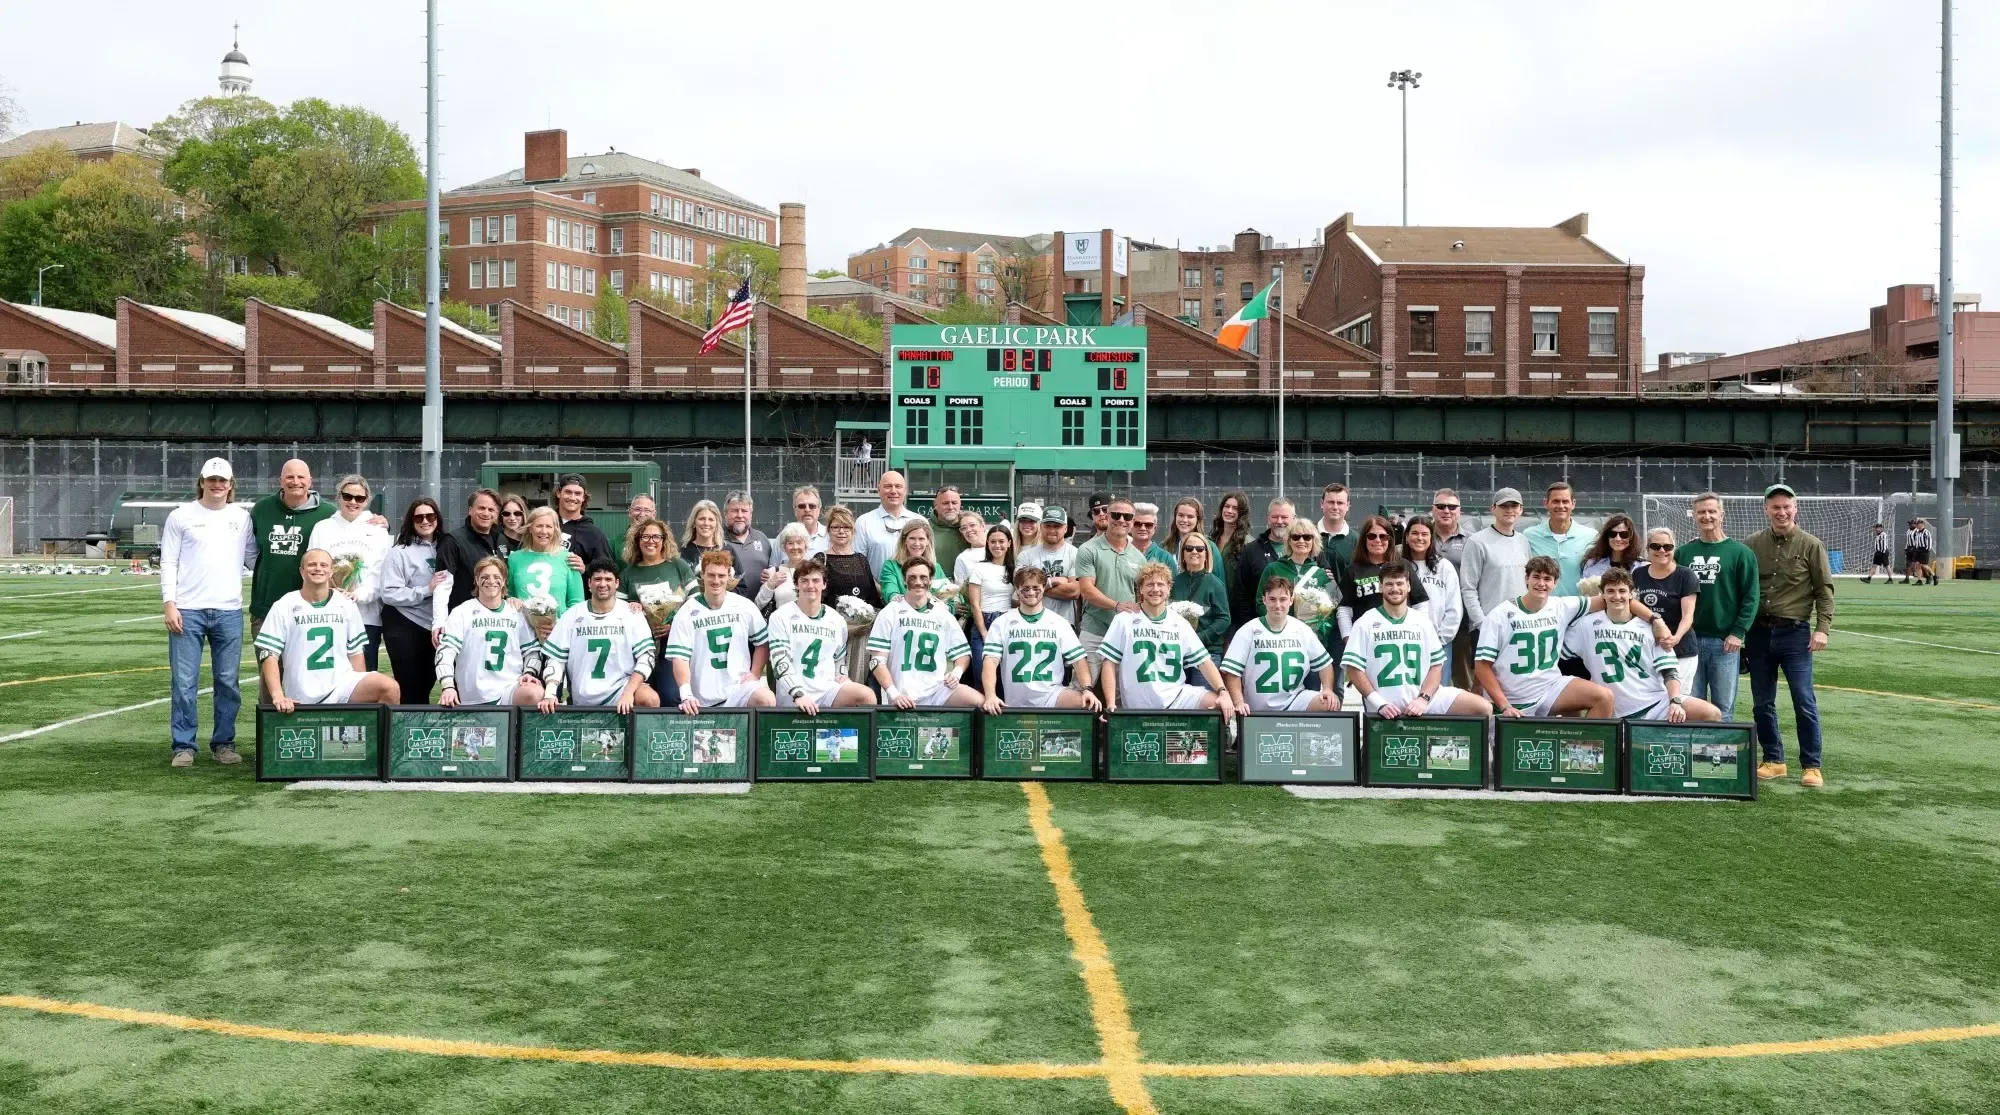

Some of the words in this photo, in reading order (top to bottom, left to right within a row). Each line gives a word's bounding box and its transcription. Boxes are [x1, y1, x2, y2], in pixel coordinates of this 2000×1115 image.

[940, 326, 1029, 345] GAELIC
[1034, 326, 1097, 345] PARK
[898, 351, 953, 361] MANHATTAN
[1090, 351, 1134, 362] CANISIUS
[928, 367, 940, 388] 0
[993, 376, 1029, 387] PERIOD
[1114, 368, 1126, 389] 0
[903, 397, 931, 405] GOALS
[949, 397, 979, 405] POINTS
[1059, 398, 1087, 406] GOALS
[1105, 398, 1134, 406] POINTS
[968, 506, 1000, 516] PARK
[271, 534, 300, 542] JASPERS
[526, 561, 553, 598] 3
[1420, 576, 1447, 589] ATTAN
[1510, 616, 1558, 631] MANHATTAN
[576, 625, 625, 637] MANHATTAN
[1008, 629, 1057, 640] MANHATTAN
[1132, 628, 1180, 641] MANHATTAN
[1373, 631, 1421, 642] MANHATTAN
[1594, 628, 1645, 643] MANHATTAN
[307, 626, 335, 671] 2
[706, 626, 733, 670] 5
[1253, 639, 1302, 649] MANHATTAN
[485, 630, 509, 672] 3
[901, 629, 940, 672] 18
[1509, 628, 1559, 675] 30
[587, 638, 612, 679] 7
[800, 638, 823, 679] 4
[1008, 641, 1058, 683] 22
[1132, 640, 1182, 683] 23
[1594, 641, 1650, 684] 34
[1373, 643, 1422, 688] 29
[1254, 651, 1305, 694] 26
[282, 739, 313, 748] JASPERS
[410, 739, 442, 748] JASPERS
[541, 740, 572, 749] JASPERS
[654, 741, 684, 750] JASPERS
[777, 741, 807, 750] JASPERS
[880, 739, 909, 748] JASPERS
[1002, 740, 1031, 749] JASPERS
[1127, 742, 1157, 751] JASPERS
[1262, 744, 1292, 753] JASPERS
[1388, 747, 1418, 756] JASPERS
[1520, 750, 1550, 759] JASPERS
[1652, 754, 1682, 763] JASPERS
